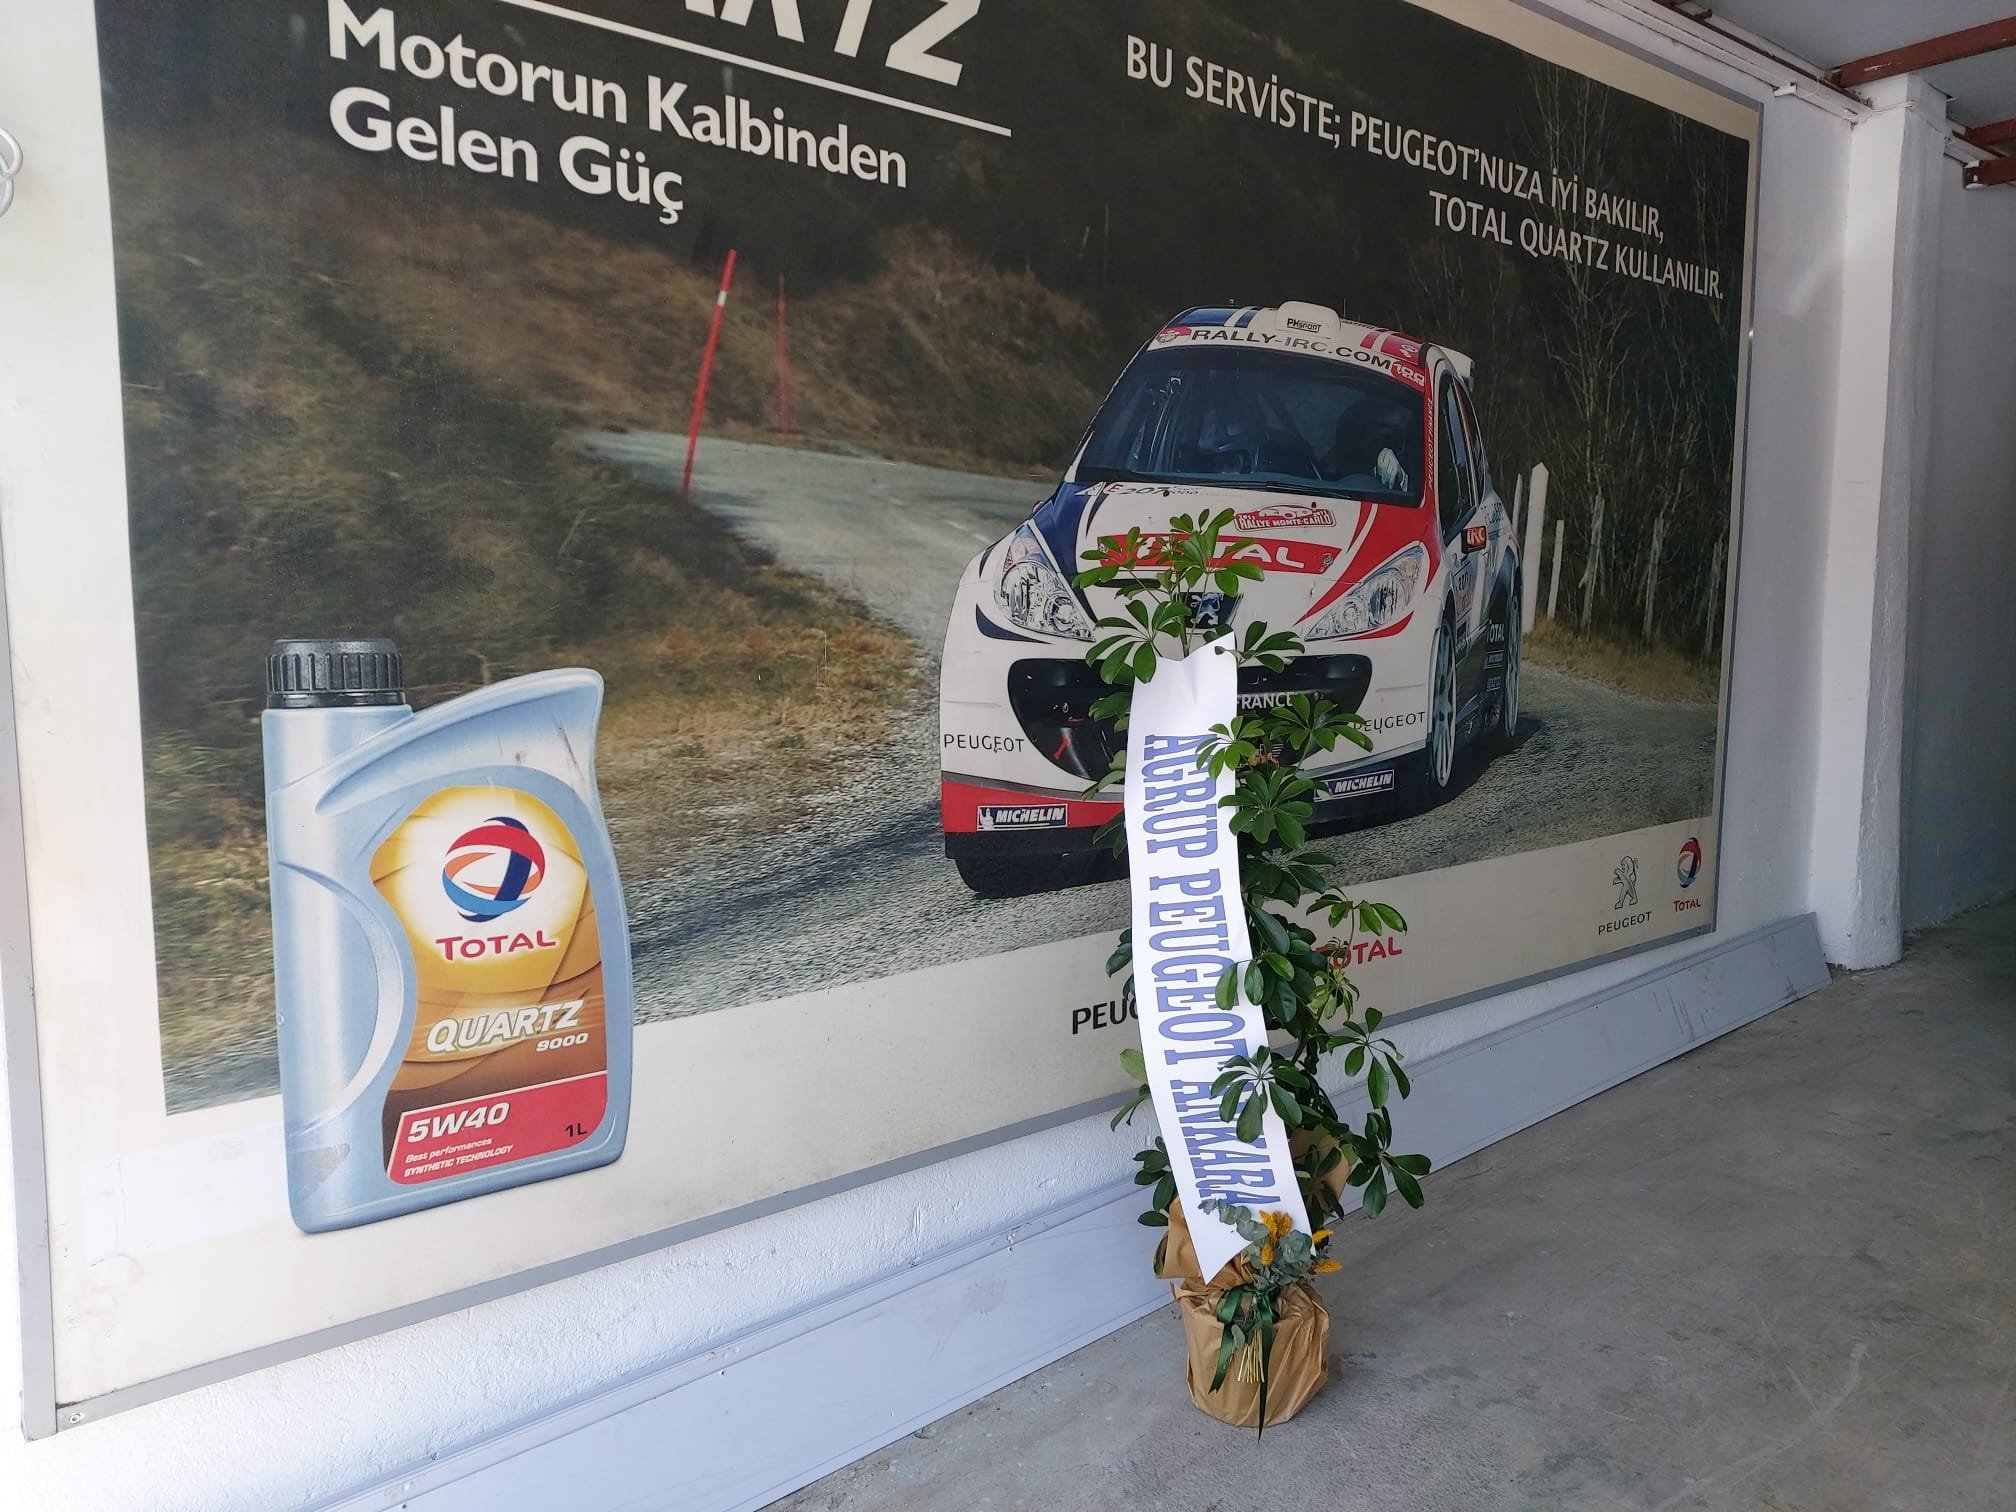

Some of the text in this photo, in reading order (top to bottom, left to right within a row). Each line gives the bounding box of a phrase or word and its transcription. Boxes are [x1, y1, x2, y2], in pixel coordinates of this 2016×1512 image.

[328, 0, 627, 124] Motorun
[648, 74, 908, 189] Kalbinden
[1127, 34, 1173, 89] BU
[1185, 55, 1341, 150] SERVİSTE;
[1551, 167, 1579, 214] İYİ
[1585, 187, 1665, 244] BAKILIR,
[329, 86, 684, 225] Gelen Güç
[1429, 190, 1724, 300] TOTAL QUARTZ KULLANILIR.
[944, 733, 1025, 753] PEUGEOT
[1334, 773, 1393, 793] MICHELIN
[995, 807, 1065, 823] MICHELIN
[1673, 898, 1702, 912] TOTAL
[1598, 910, 1653, 935] PEUGEOT
[436, 931, 557, 960] TOTAL
[426, 1000, 586, 1054] QUARTZ
[535, 1032, 588, 1052] 9000
[407, 1101, 511, 1144] 5W40
[404, 1144, 514, 1177] SYNTHETIC TECHNOLOGY
[405, 1137, 493, 1164] Best performances
